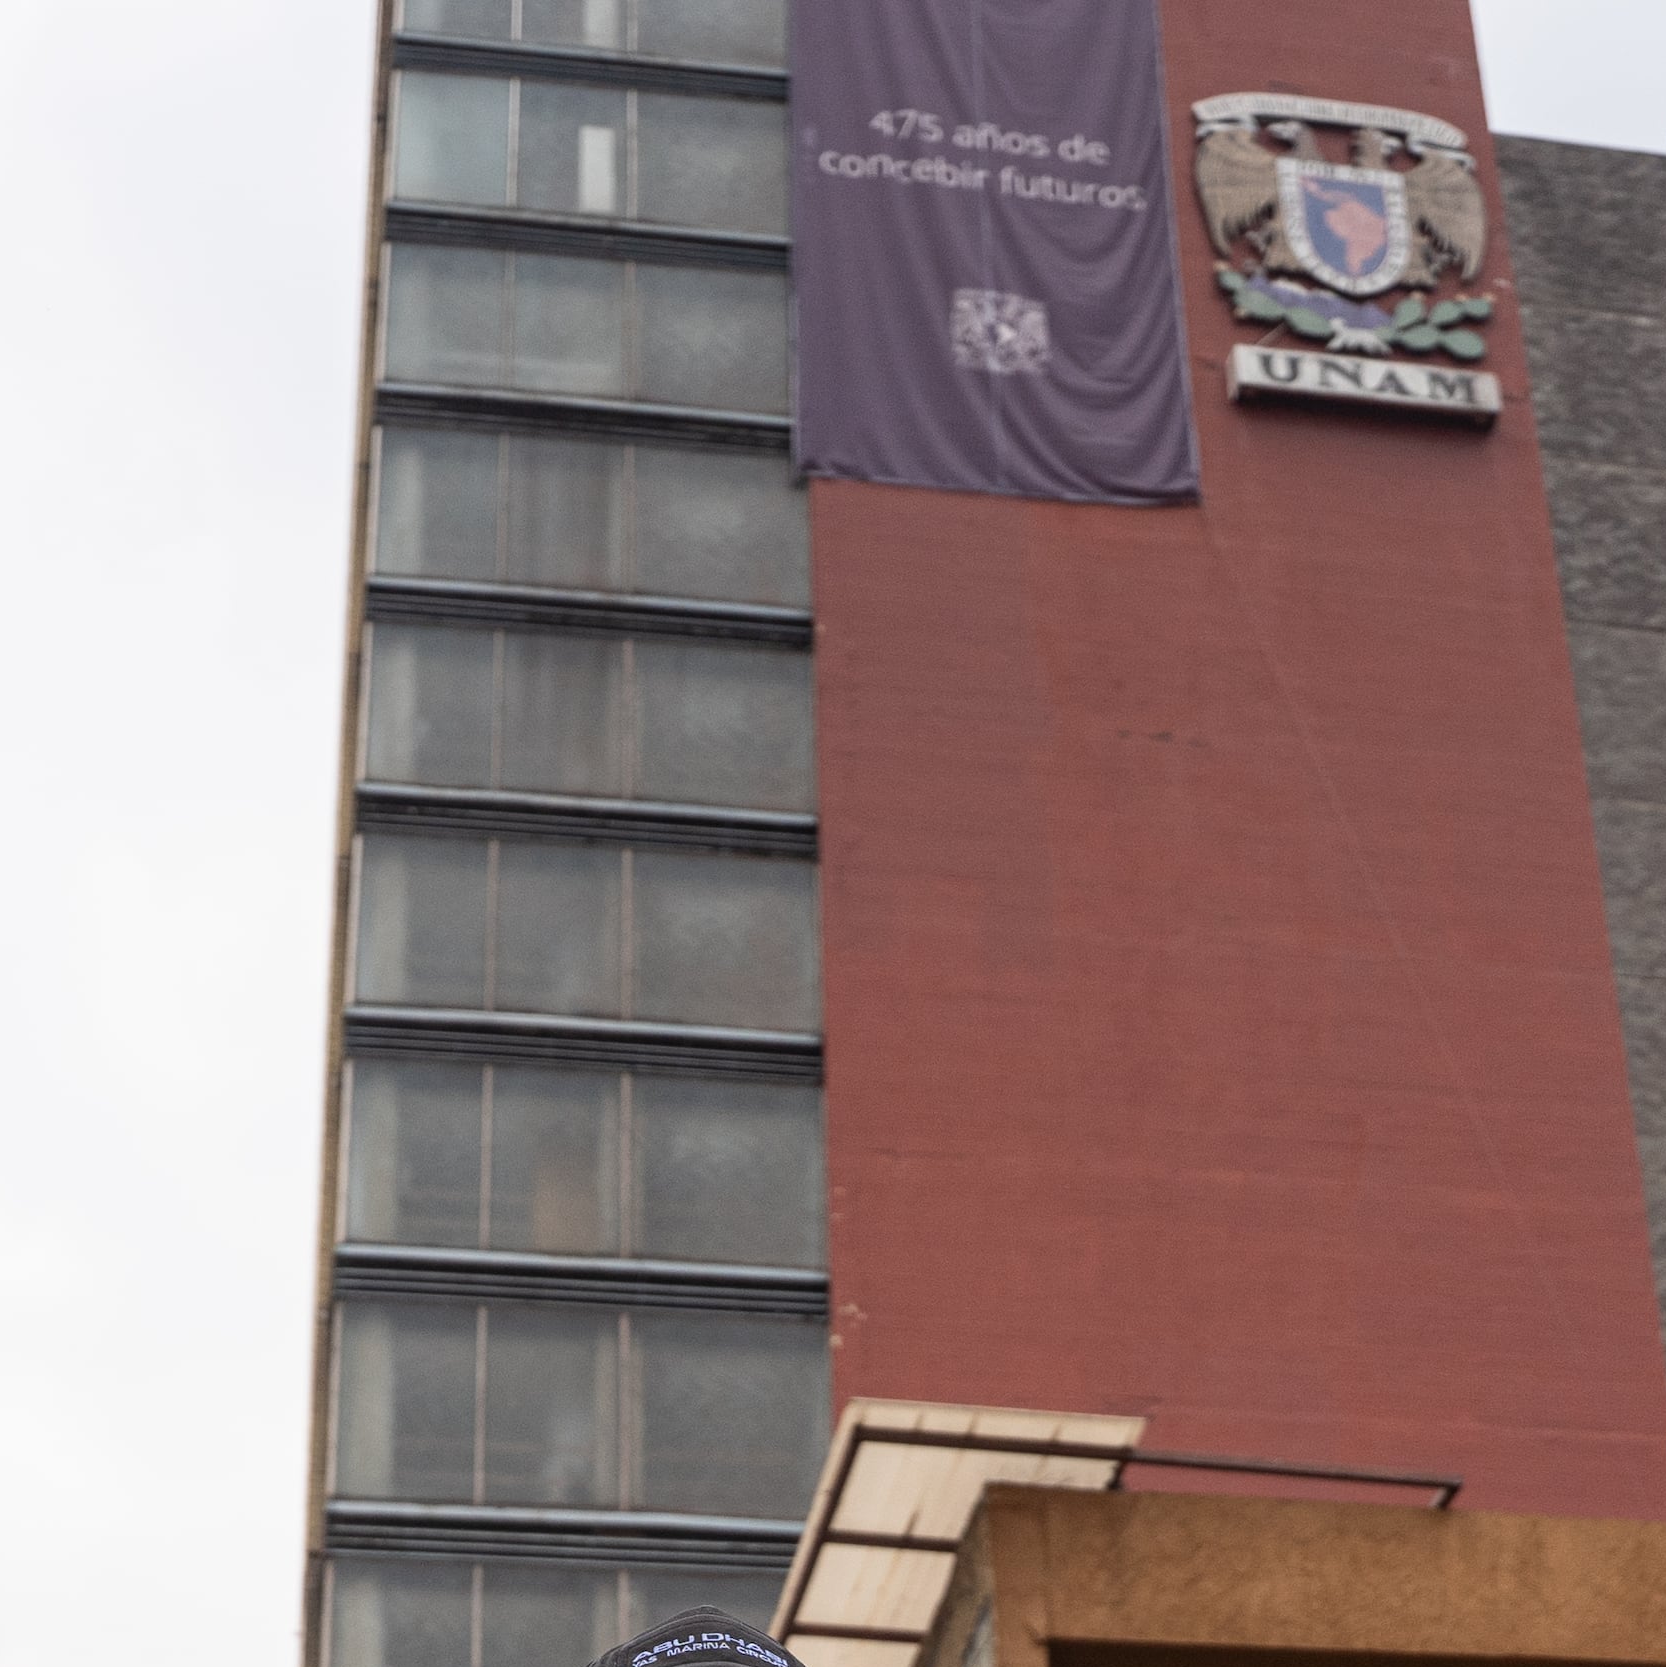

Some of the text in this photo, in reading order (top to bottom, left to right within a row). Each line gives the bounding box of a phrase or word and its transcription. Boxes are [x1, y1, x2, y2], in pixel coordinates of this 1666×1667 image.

[869, 108, 1111, 166] 475 años de
[817, 150, 1148, 212] concebir futuros
[1257, 352, 1476, 405] UNAM
[632, 1632, 789, 1667] ABU DHABI
[665, 1641, 731, 1658] MARINA
